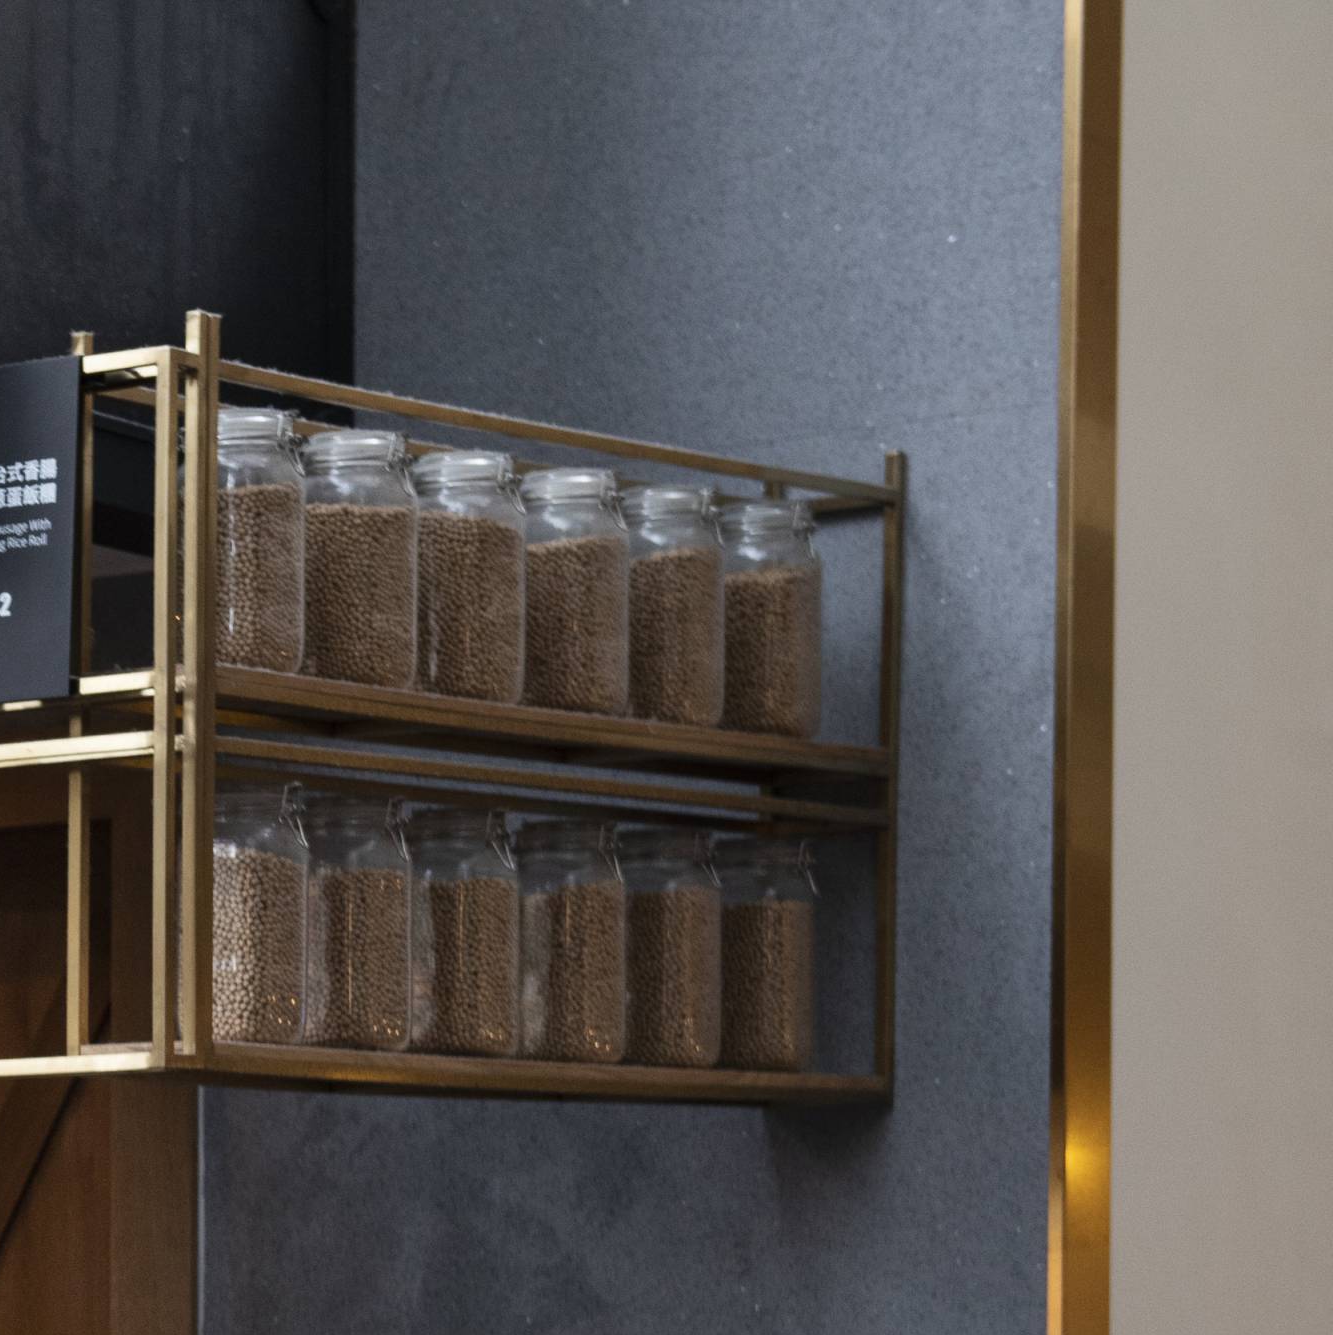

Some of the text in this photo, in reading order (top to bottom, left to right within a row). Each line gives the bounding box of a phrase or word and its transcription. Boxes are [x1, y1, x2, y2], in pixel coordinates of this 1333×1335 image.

[29, 517, 53, 532] With
[7, 536, 28, 549] Rice
[28, 533, 48, 546] Roll
